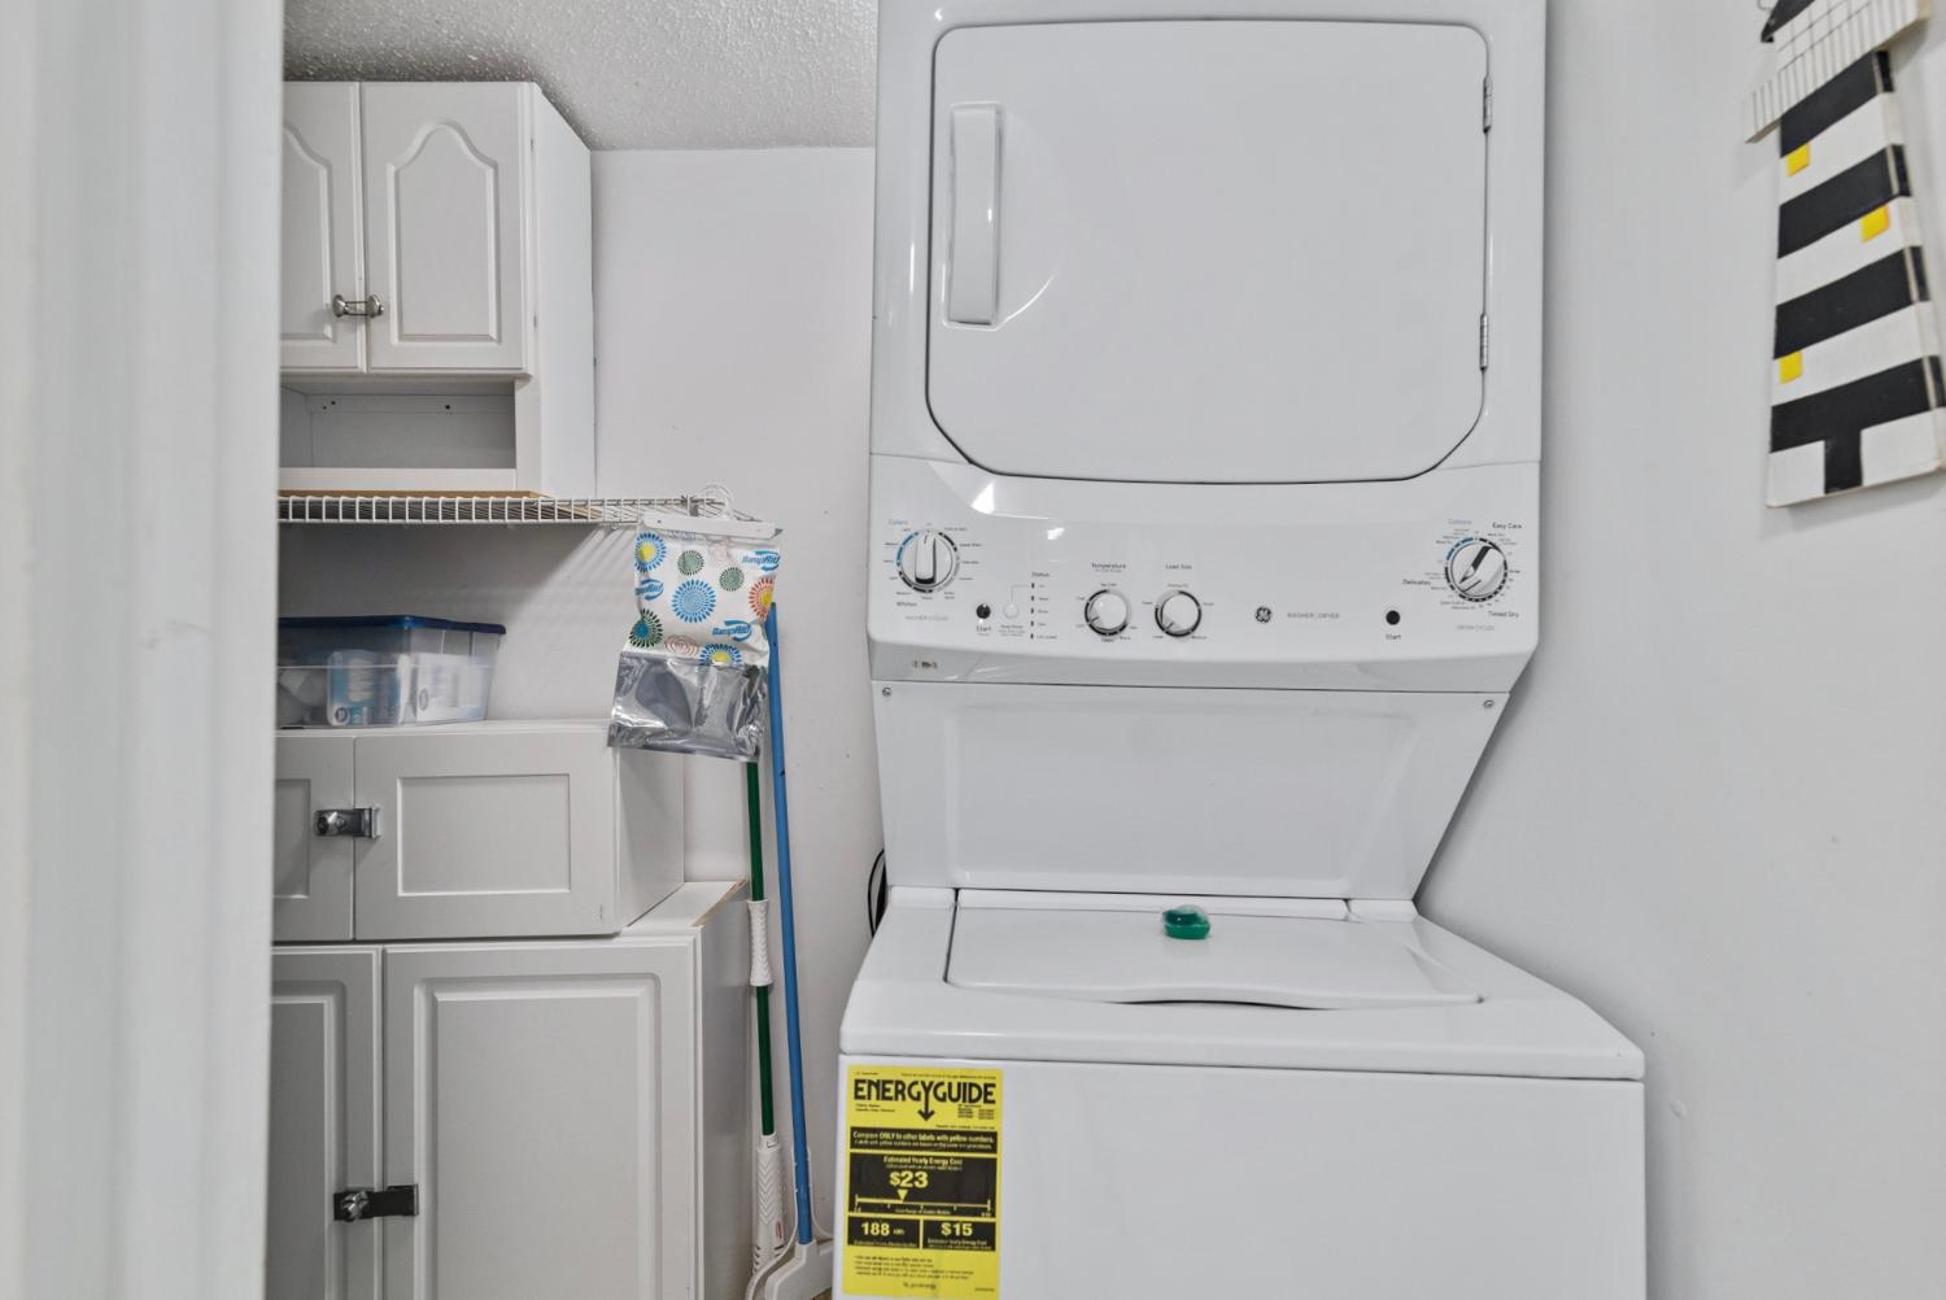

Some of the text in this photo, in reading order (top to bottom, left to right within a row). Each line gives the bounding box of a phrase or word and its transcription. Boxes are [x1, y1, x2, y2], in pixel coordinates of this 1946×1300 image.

[854, 1078, 997, 1105] ENERGYGUIDE
[889, 1170, 929, 1188] $23
[861, 1221, 890, 1236] 188
[941, 1222, 973, 1237] $15
